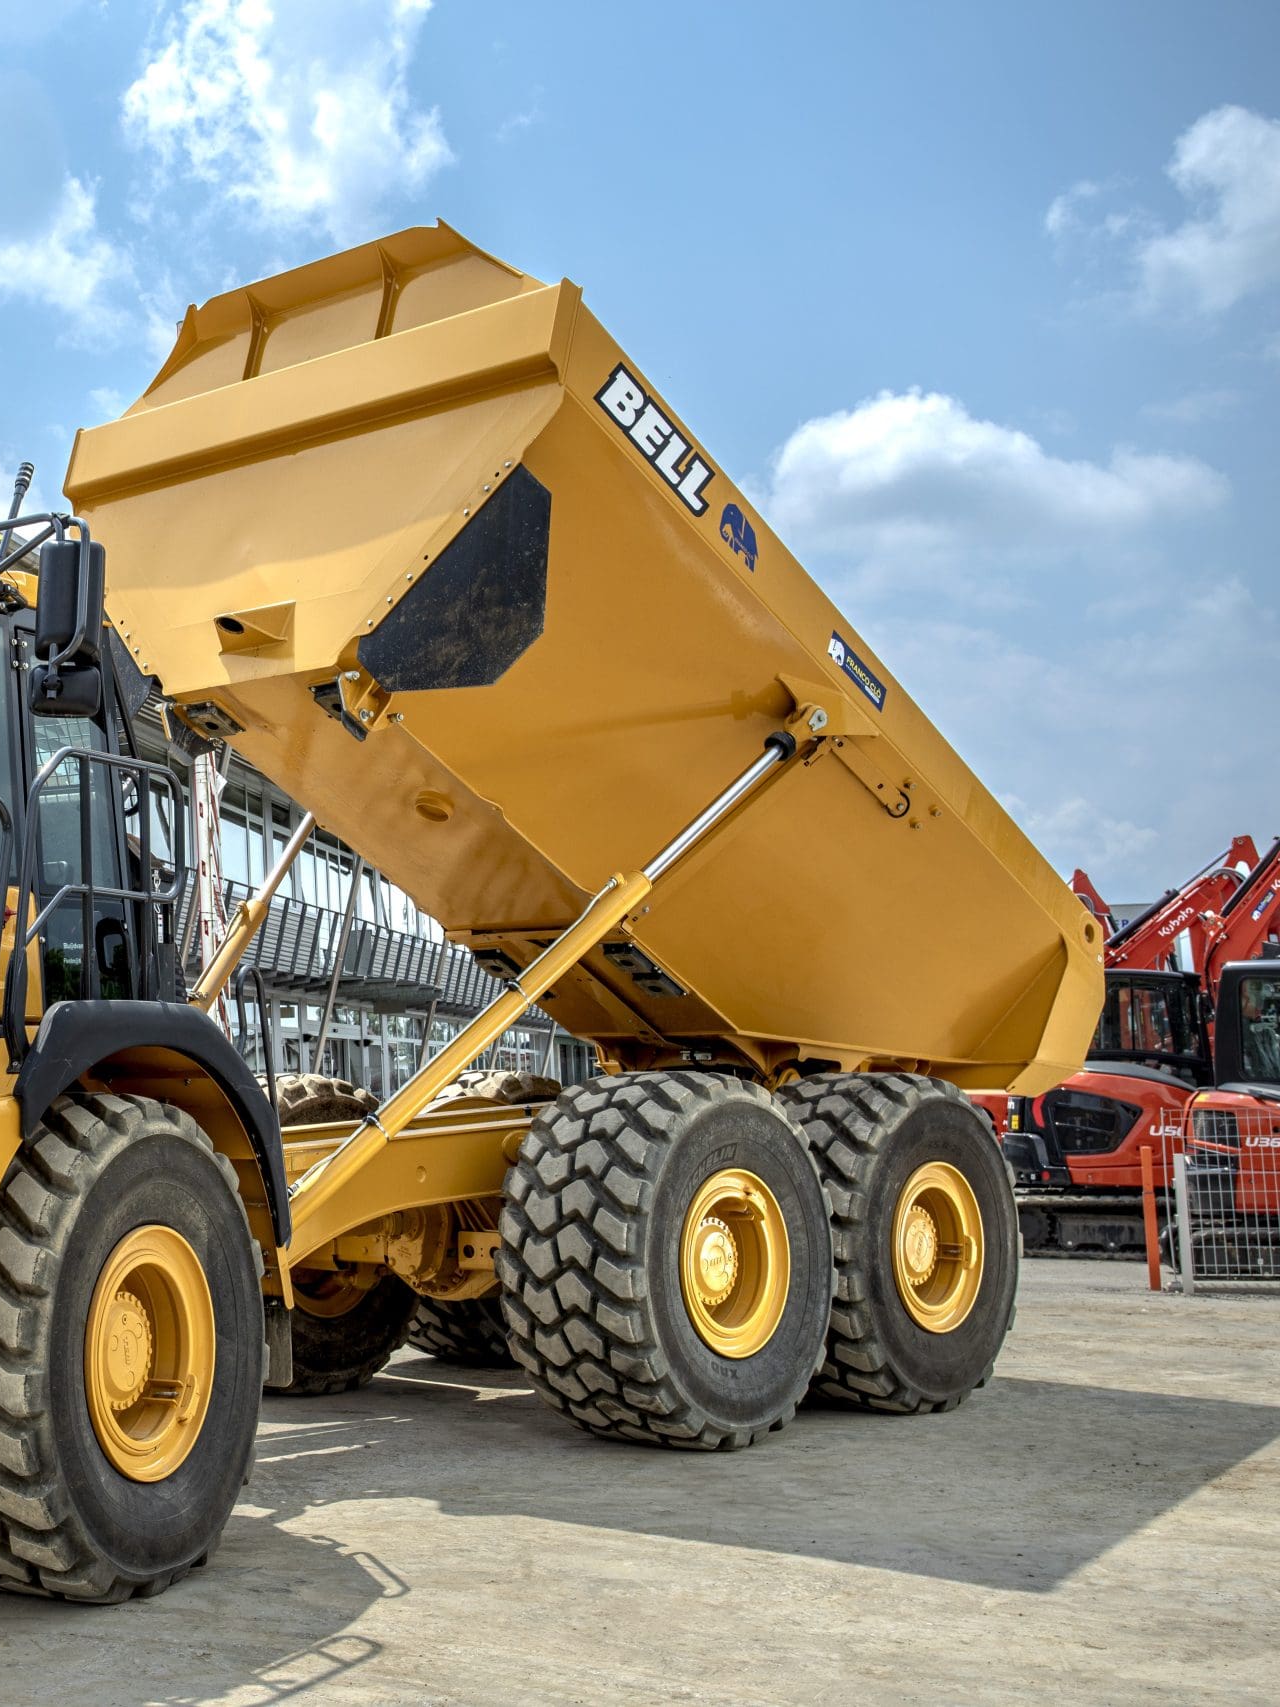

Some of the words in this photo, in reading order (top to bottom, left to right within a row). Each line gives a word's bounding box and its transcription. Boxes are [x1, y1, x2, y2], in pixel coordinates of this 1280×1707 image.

[595, 364, 713, 515] BELL
[846, 655, 870, 685] FRANCO
[1157, 906, 1195, 938] Kubota
